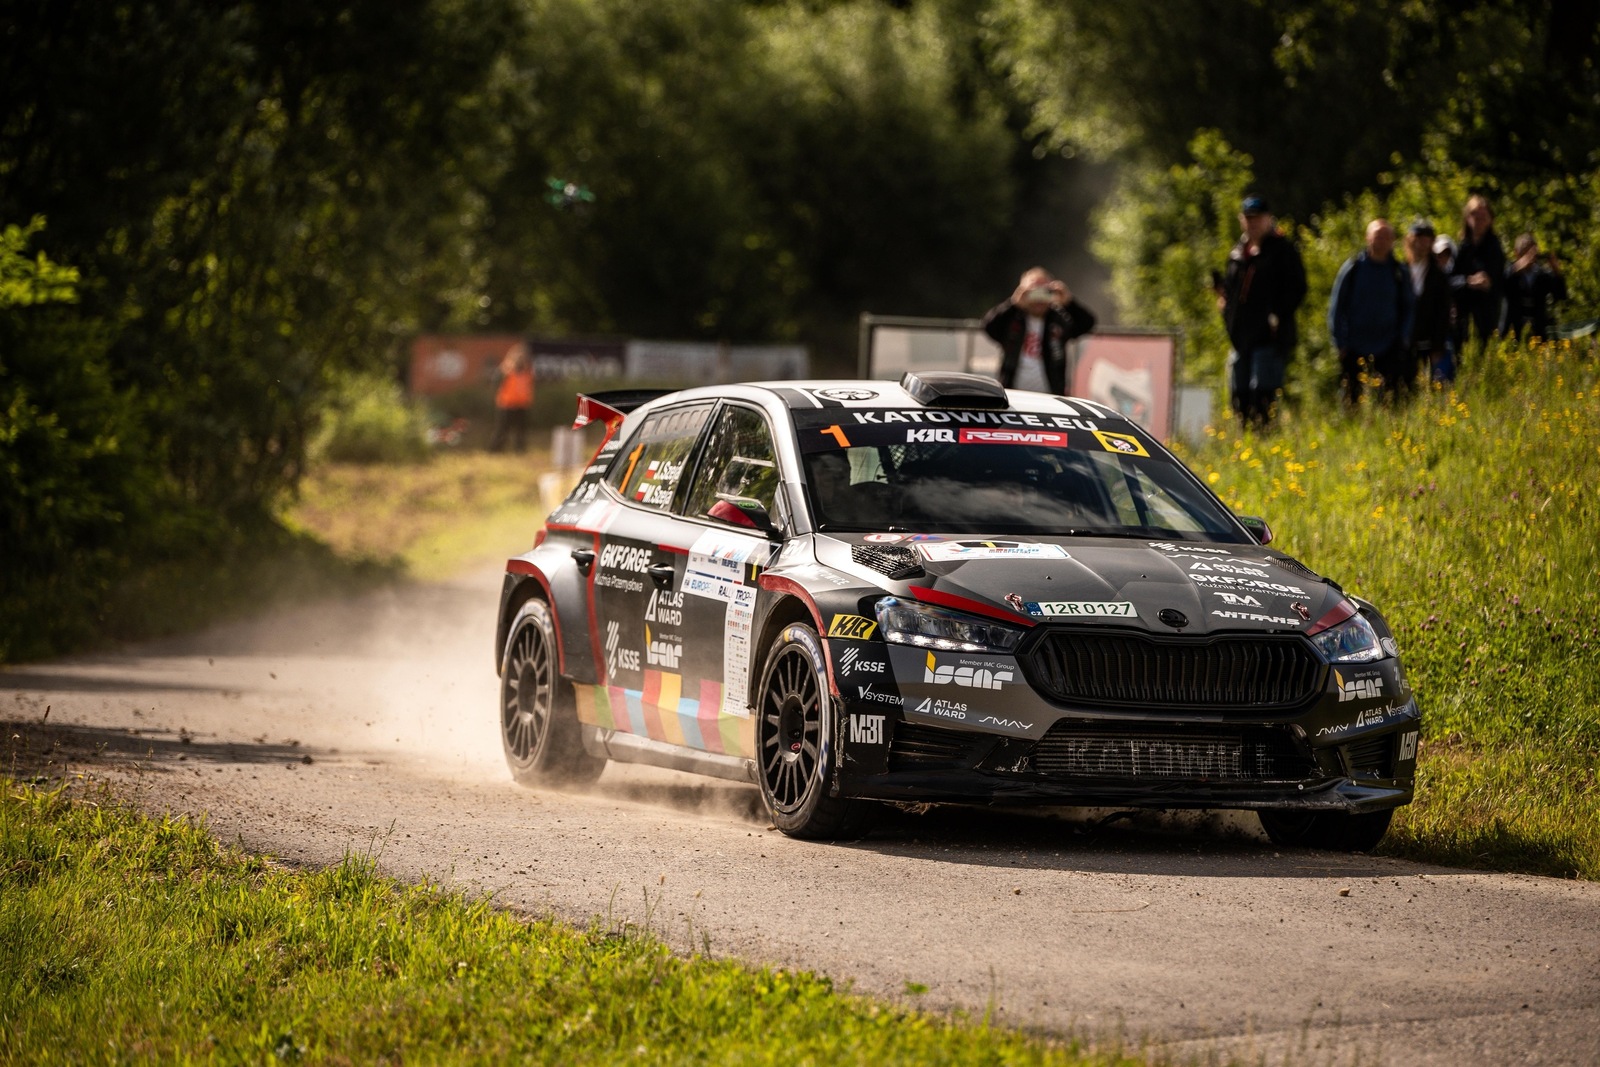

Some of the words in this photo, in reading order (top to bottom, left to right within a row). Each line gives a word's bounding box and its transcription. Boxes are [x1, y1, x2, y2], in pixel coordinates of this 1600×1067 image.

[853, 412, 1098, 431] KATOWICE.EU
[820, 425, 851, 447] 1
[966, 431, 1061, 443] RSMP
[618, 442, 645, 494] 1
[1179, 546, 1231, 555] KSSE
[600, 544, 652, 574] GKFORGE
[1188, 573, 1306, 595] GKFORGE
[1197, 581, 1236, 590] Kuźnia
[659, 590, 684, 608] ATLAS
[1044, 603, 1082, 616] 12R
[1087, 603, 1131, 616] 0127
[658, 608, 682, 626] WARD
[618, 648, 640, 671] KSSE
[854, 660, 886, 673] KSSE
[996, 662, 1015, 671] Group
[934, 699, 967, 711] ATLAS
[933, 708, 966, 720] WARD
[1364, 707, 1382, 718] ATLAS
[979, 716, 1034, 730] SMAY
[1365, 715, 1384, 726] WARD
[1316, 723, 1349, 737] SMAY
